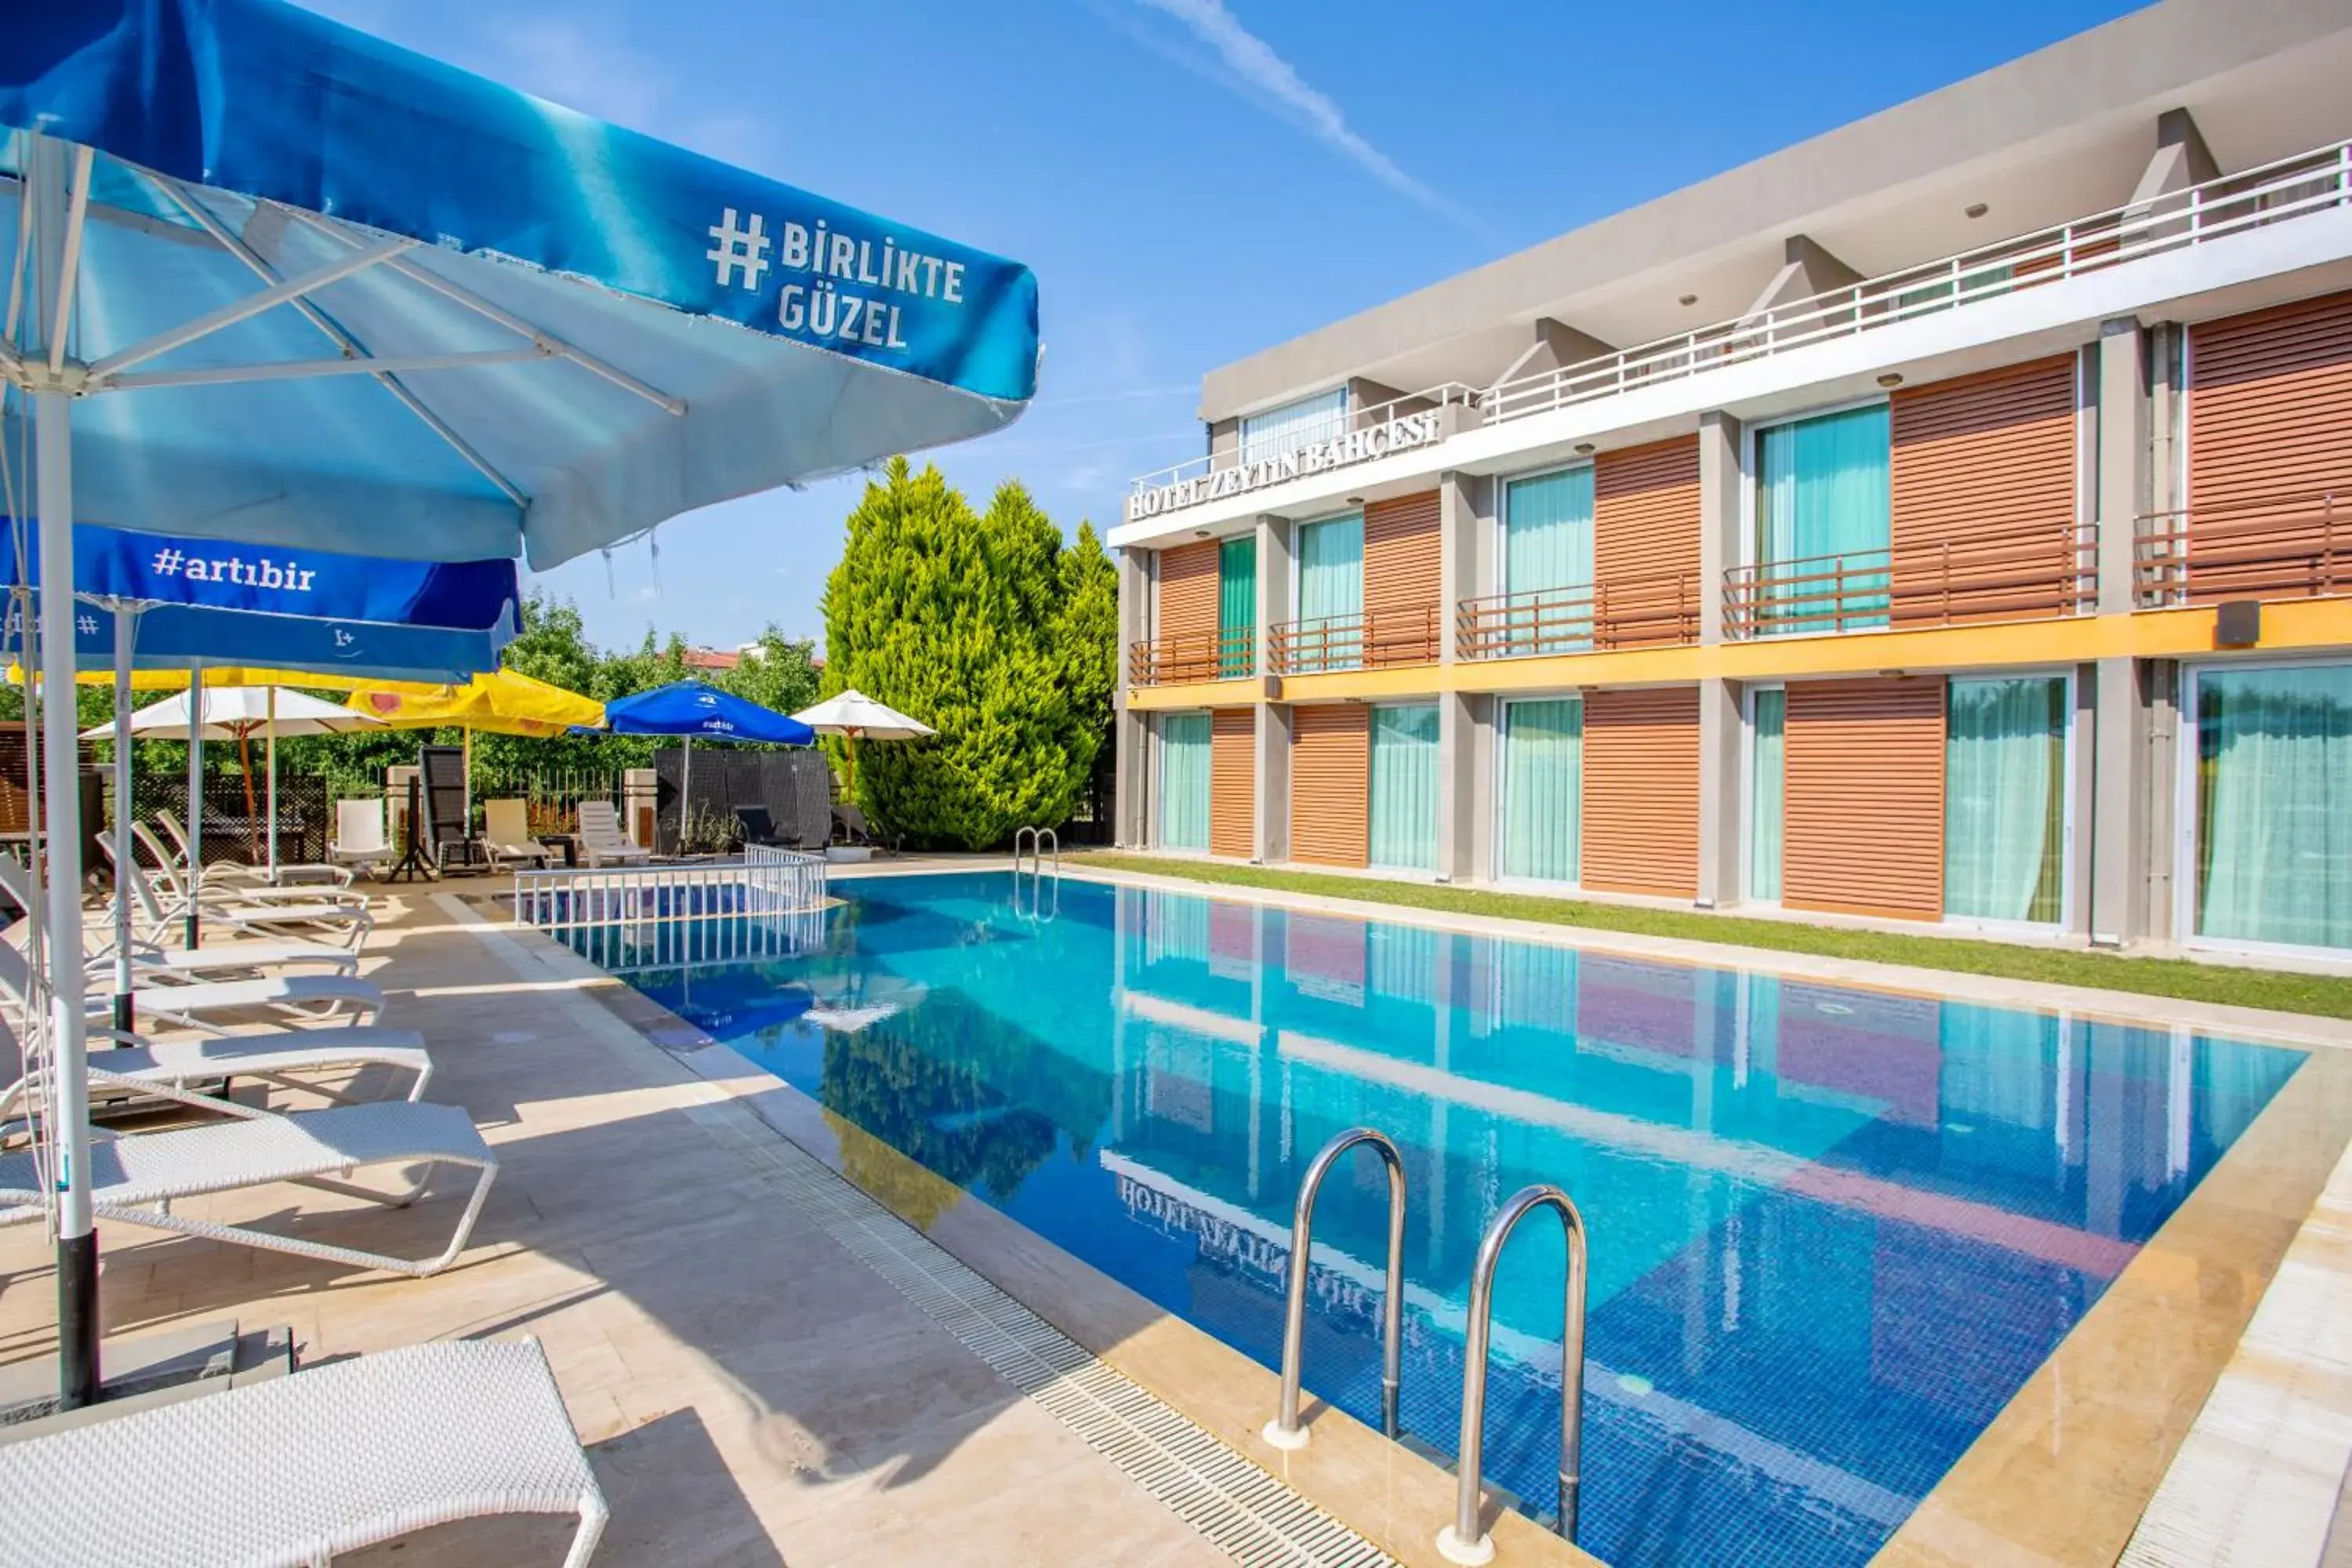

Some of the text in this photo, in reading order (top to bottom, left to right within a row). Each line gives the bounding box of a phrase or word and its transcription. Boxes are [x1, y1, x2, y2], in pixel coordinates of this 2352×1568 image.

[782, 220, 965, 303] BİRLİKTE
[779, 281, 907, 348] GÜZEL
[1128, 412, 1441, 520] HOTEL ZEYTİN BAHÇESİ
[151, 548, 316, 591] #artıbir
